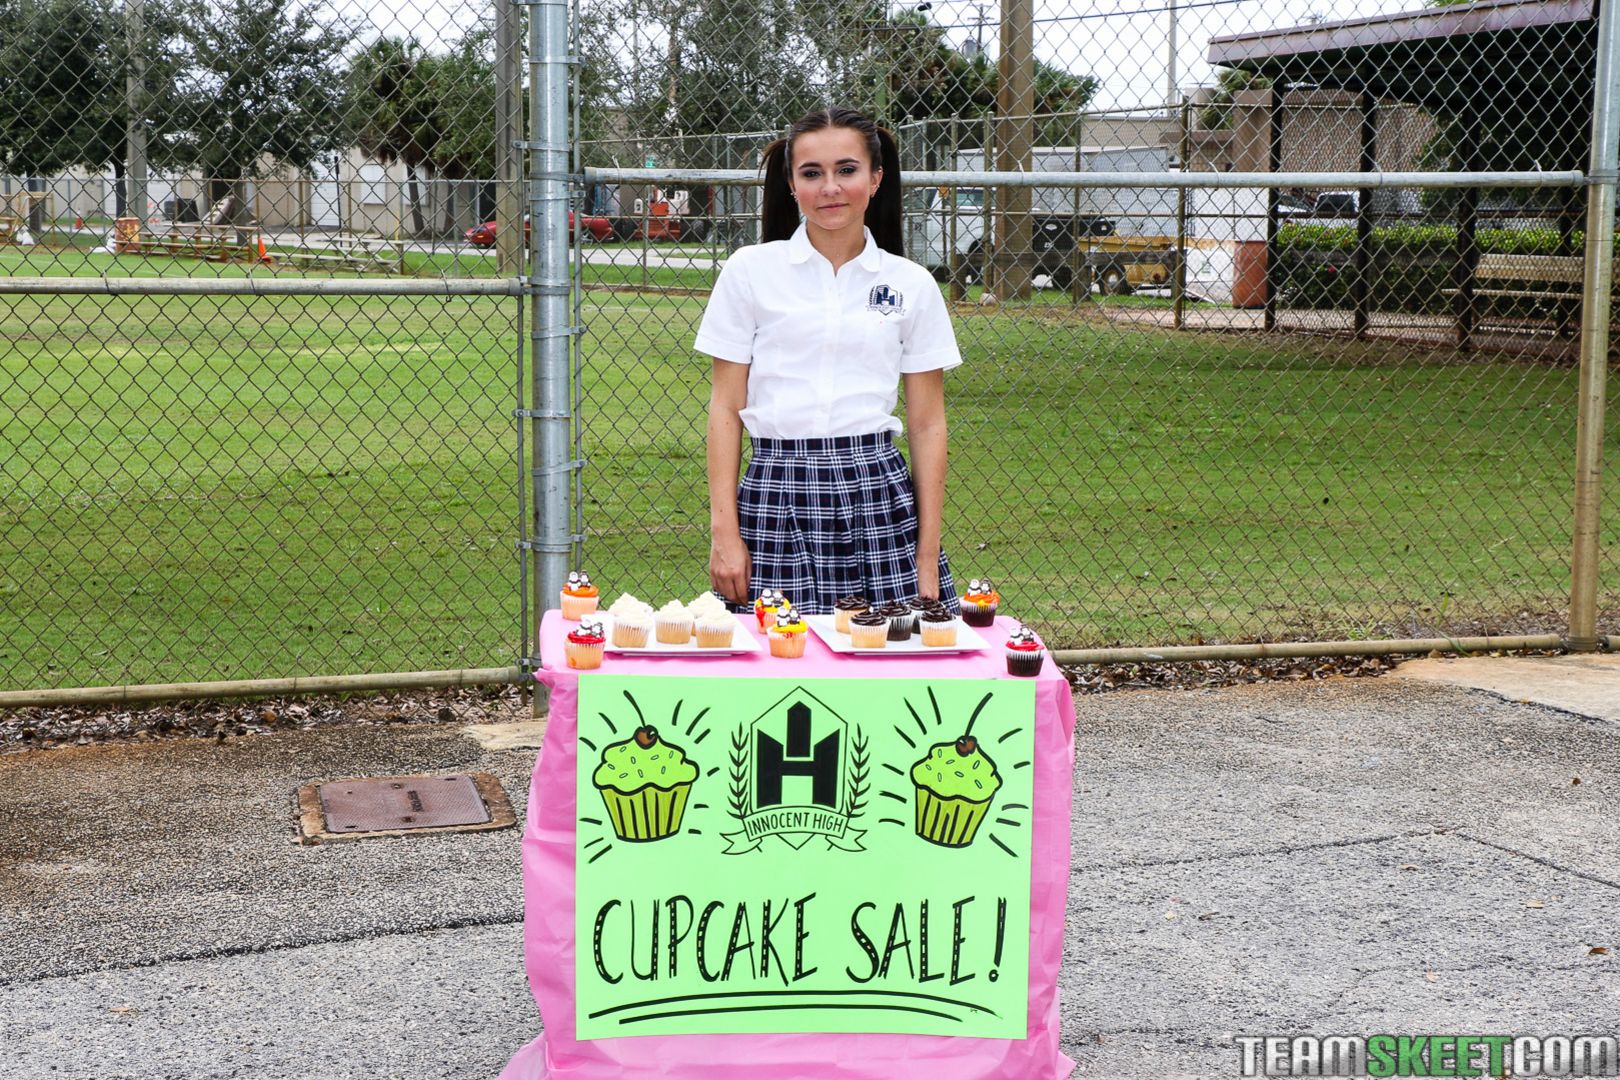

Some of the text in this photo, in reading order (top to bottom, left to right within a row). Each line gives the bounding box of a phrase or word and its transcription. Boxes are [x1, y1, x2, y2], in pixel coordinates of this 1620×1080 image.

[747, 812, 844, 837] INNOCENT HIGH
[593, 892, 1007, 986] CUPCAKE SALE!
